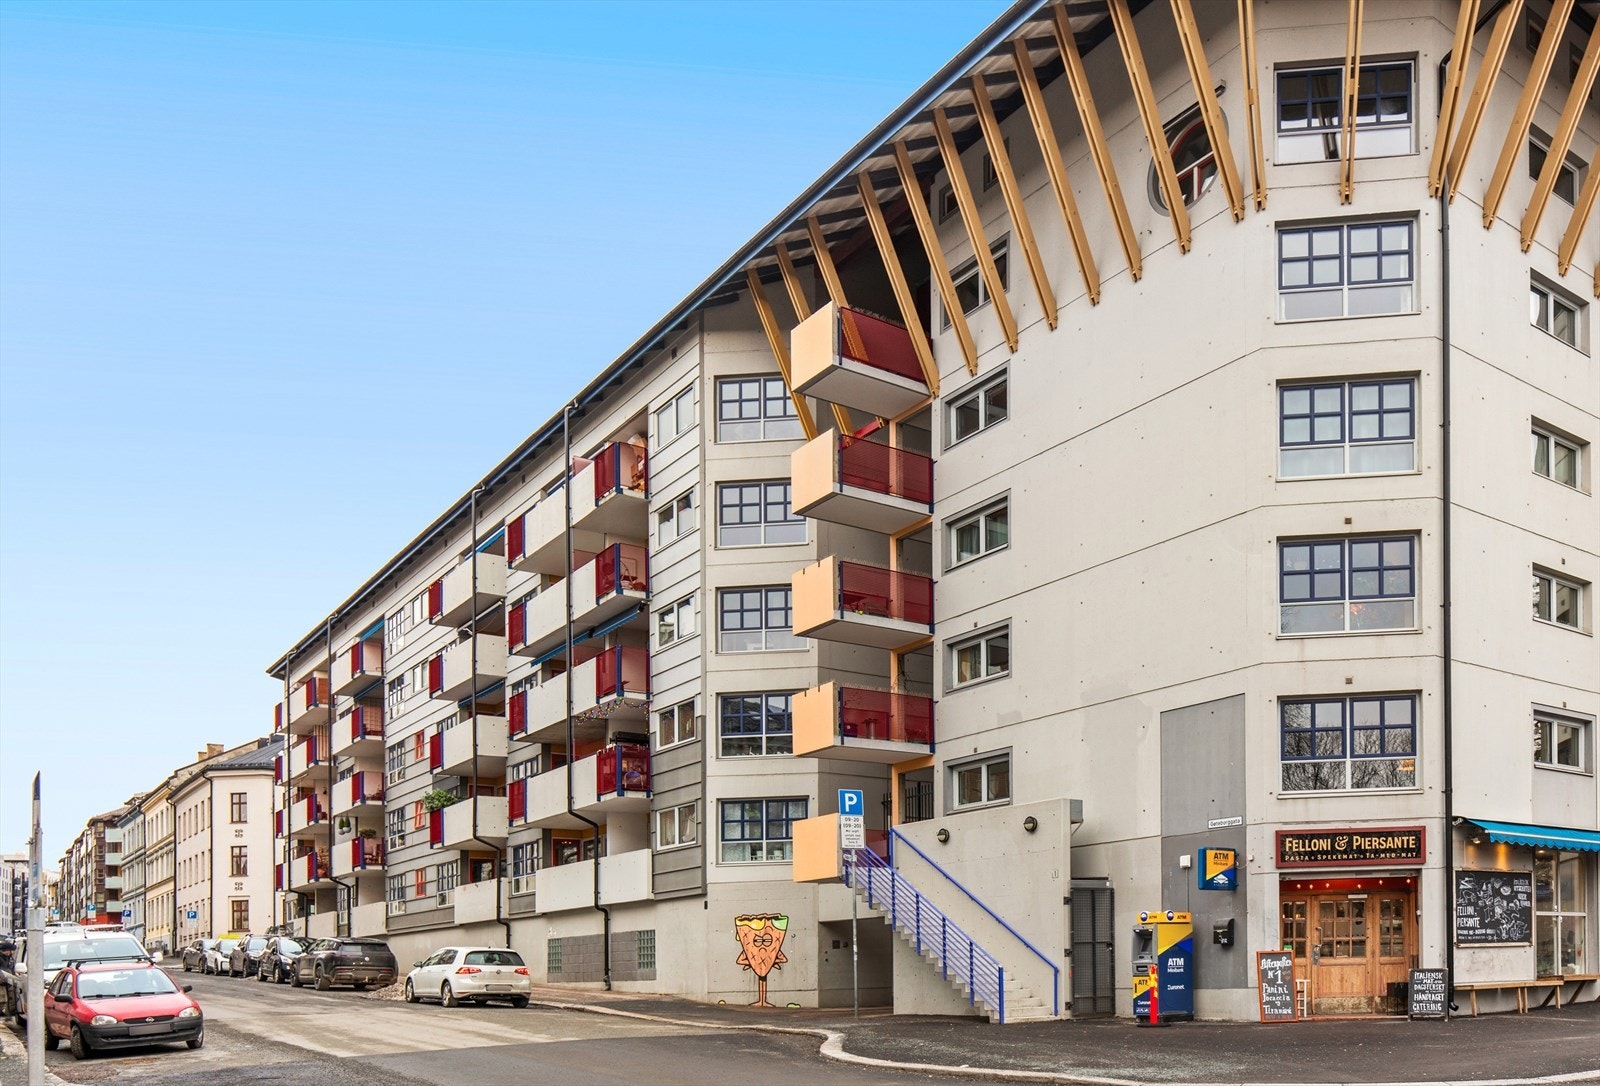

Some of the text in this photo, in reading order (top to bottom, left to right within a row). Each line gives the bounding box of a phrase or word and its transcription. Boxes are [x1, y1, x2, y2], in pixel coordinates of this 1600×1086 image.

[845, 793, 857, 812] P
[1285, 835, 1416, 852] FELLONI & PIERSANTE
[1213, 852, 1229, 860] ATM
[1167, 958, 1184, 966] ATM
[1262, 983, 1288, 993] Panini
